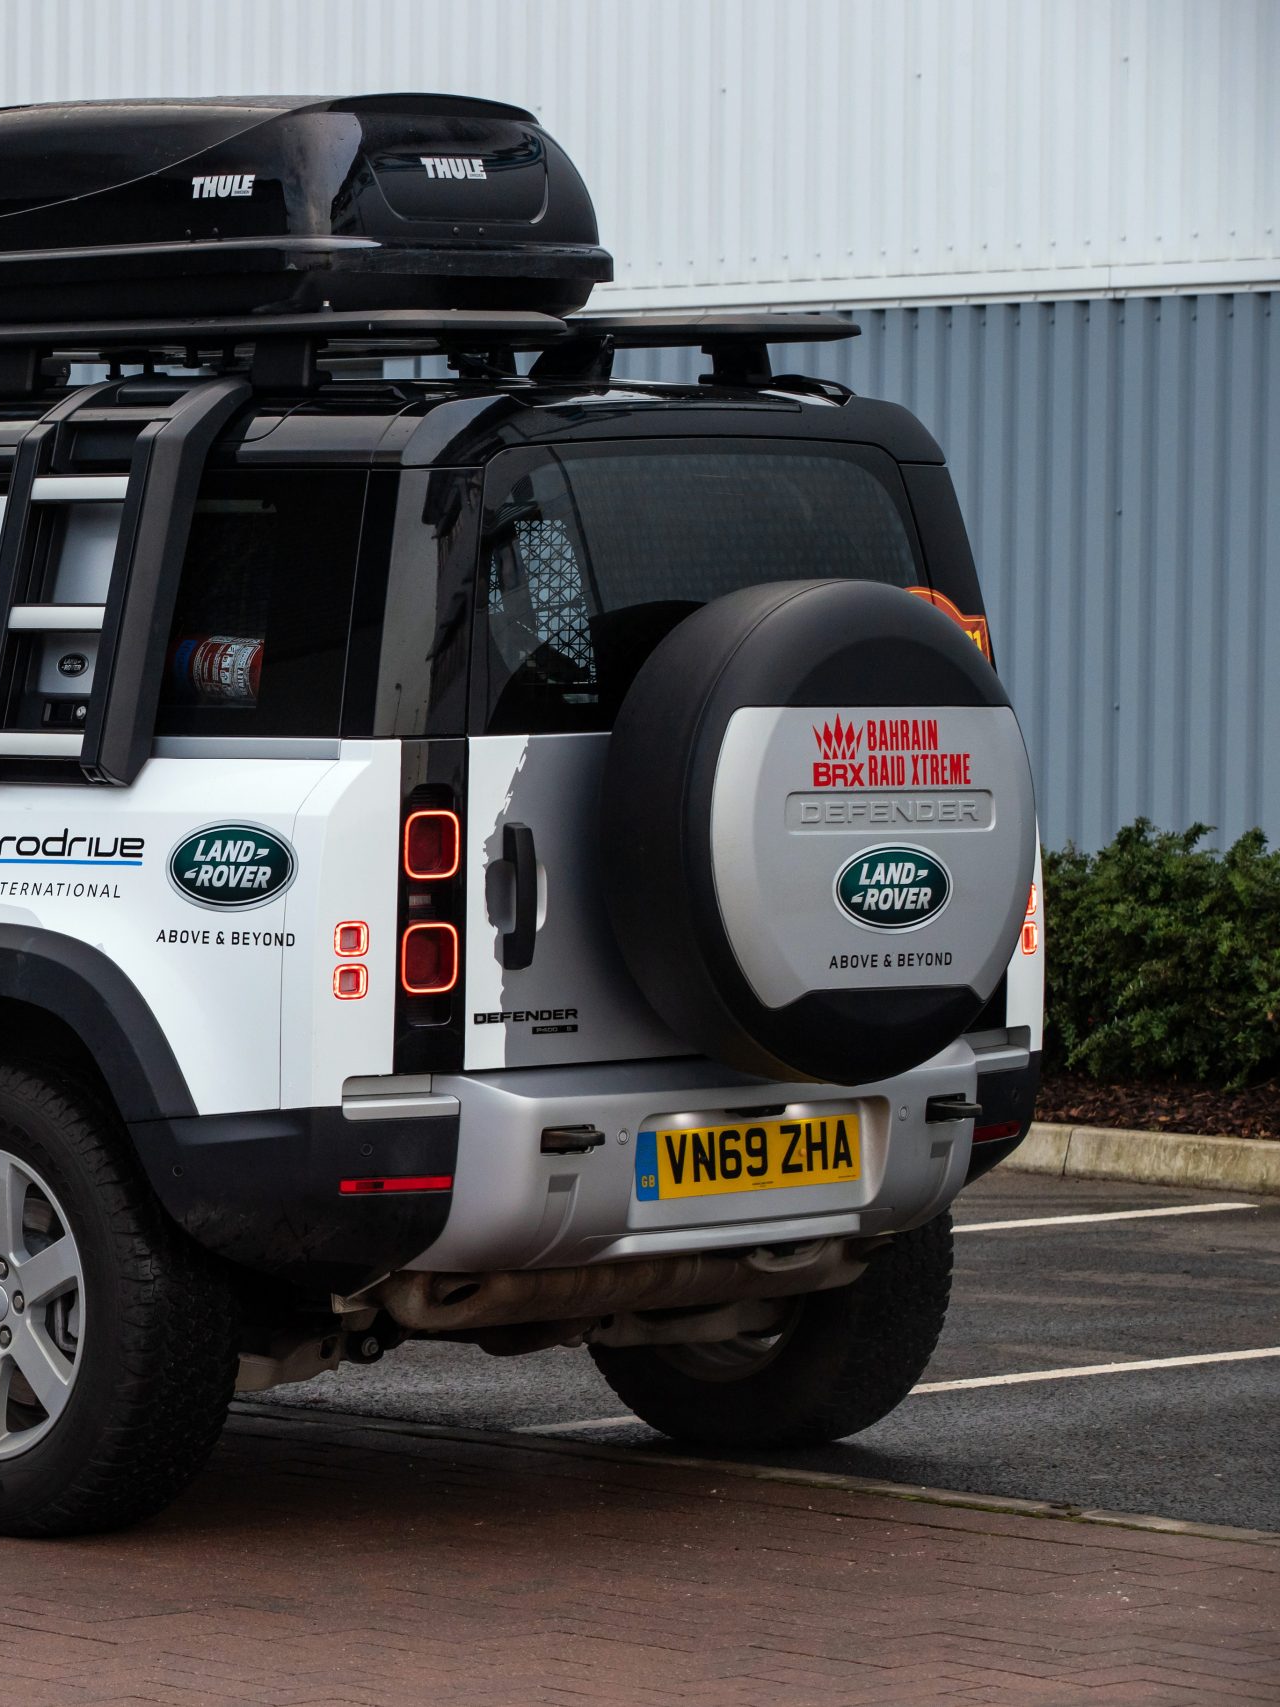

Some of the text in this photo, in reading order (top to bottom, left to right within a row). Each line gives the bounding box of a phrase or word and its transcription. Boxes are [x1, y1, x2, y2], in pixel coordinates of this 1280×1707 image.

[420, 157, 487, 180] THULE
[192, 174, 256, 199] THULE
[867, 719, 939, 751] BAHRAIN
[813, 762, 865, 787] BRX
[869, 752, 972, 786] RAID XTREME
[800, 799, 980, 824] DEFENDER
[156, 929, 296, 947] ABOVE & BEYOND
[829, 952, 953, 969] ABOVE & BEYOND
[473, 1008, 578, 1025] DEFENDER
[664, 1119, 853, 1185] VN69 ZHA
[641, 1175, 655, 1188] GB
